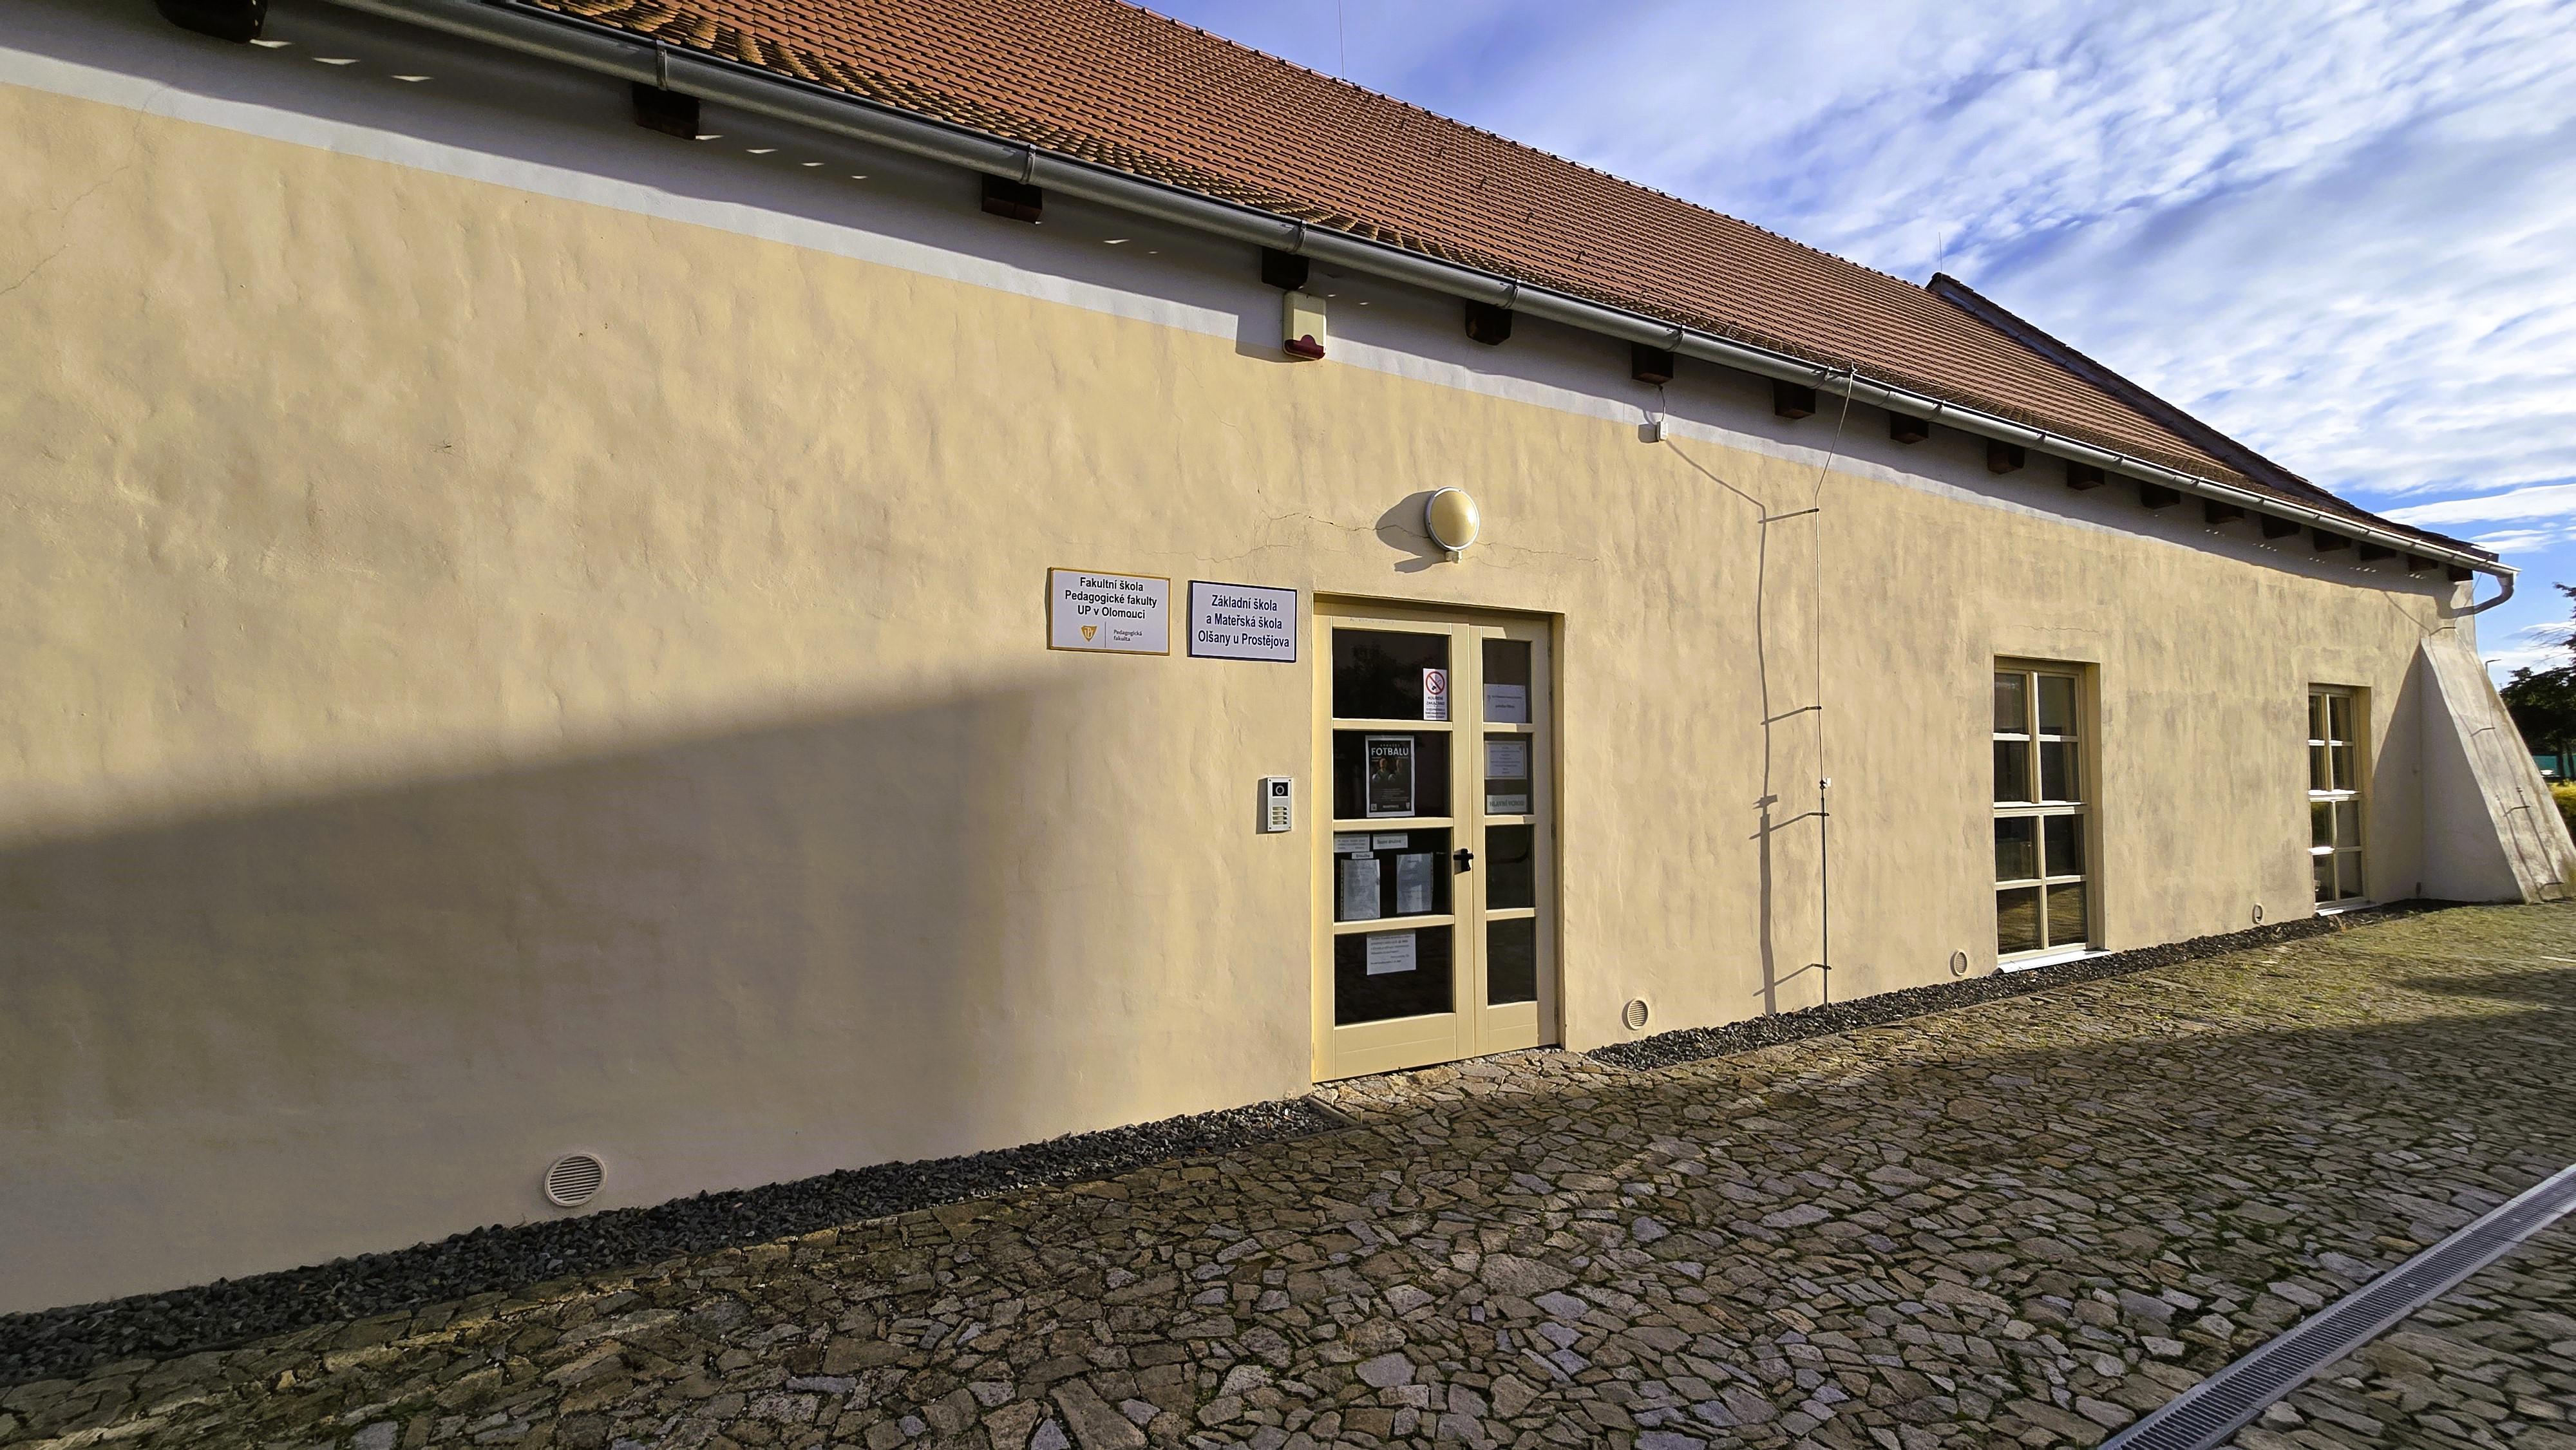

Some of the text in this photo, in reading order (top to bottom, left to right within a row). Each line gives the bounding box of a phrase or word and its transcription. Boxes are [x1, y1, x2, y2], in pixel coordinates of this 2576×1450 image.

[1080, 577, 1144, 591] Fakultní škola
[1065, 590, 1157, 608] Pedagogické fakulty
[1211, 594, 1277, 611] Základní škola
[1077, 605, 1091, 615] UP
[1102, 607, 1145, 619] Olomouci
[1206, 613, 1282, 629] a Mateřská škola
[1198, 630, 1289, 649] Olšany u Prostějova
[1371, 748, 1408, 756] FOTBALU
